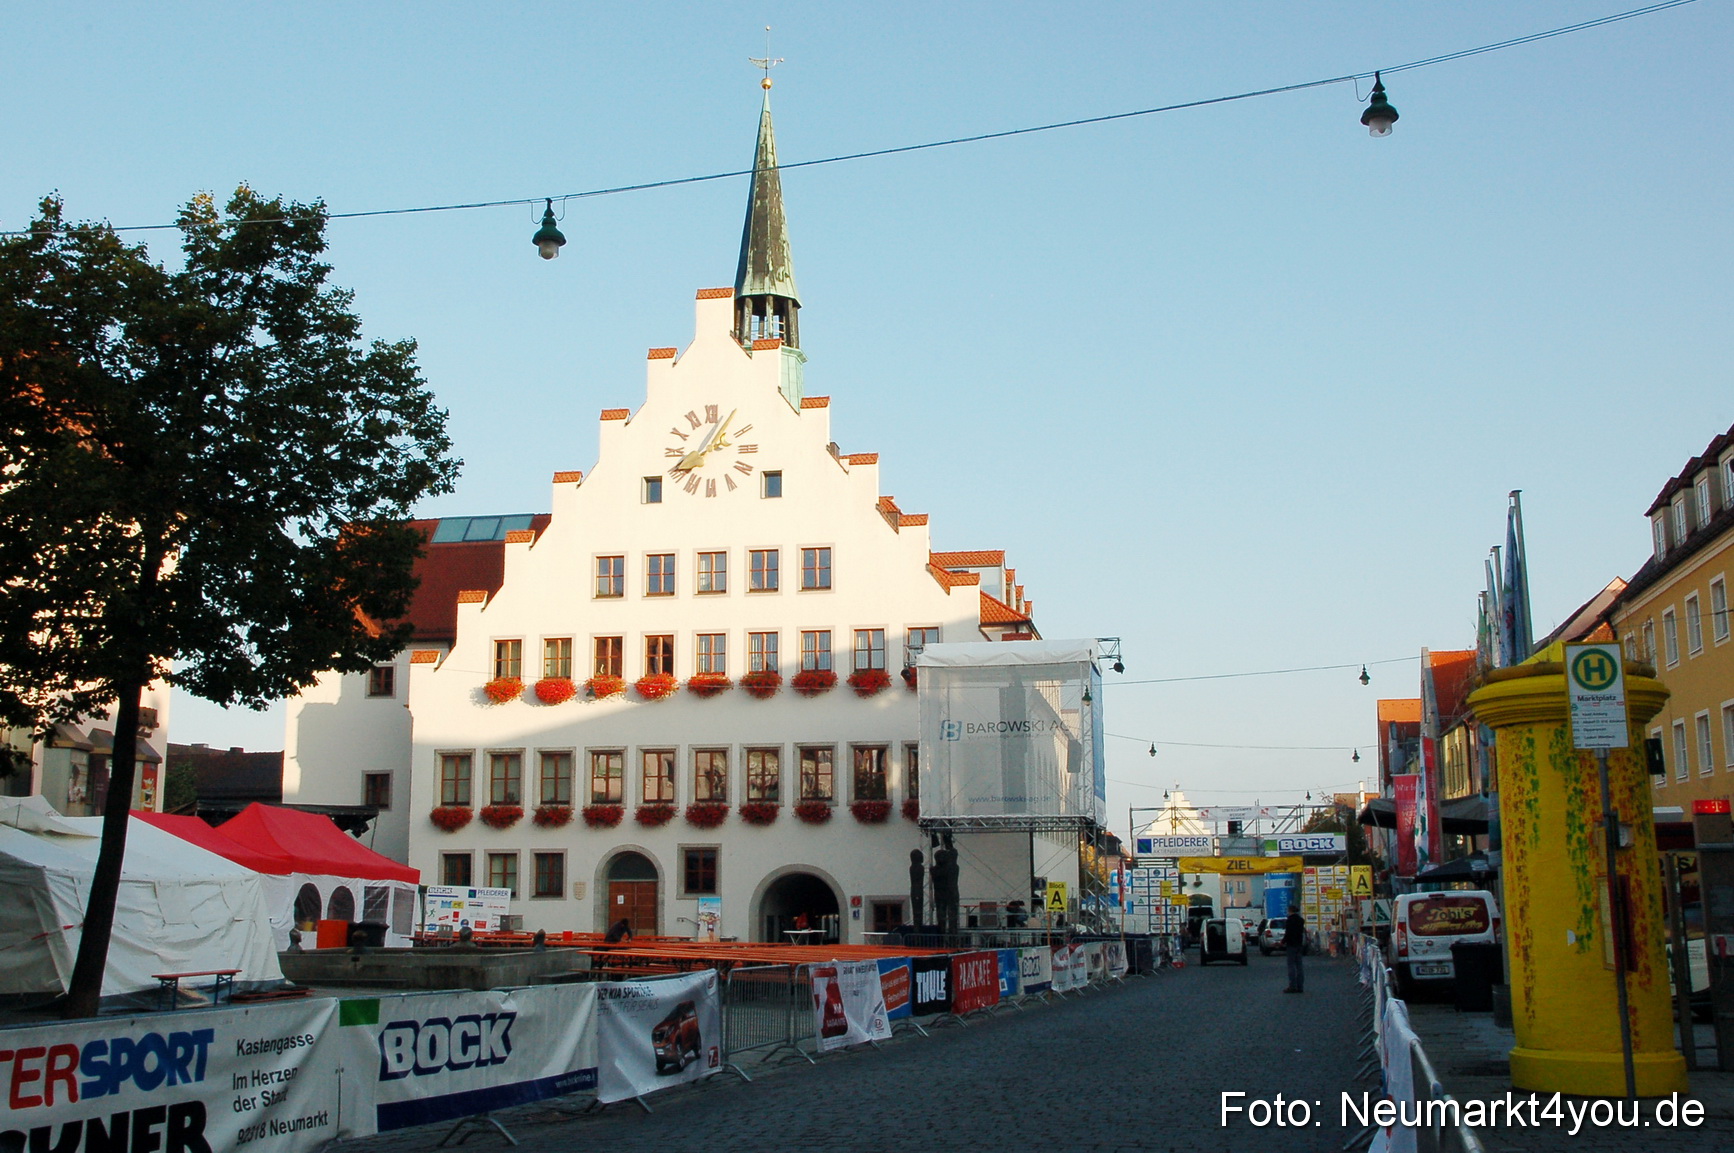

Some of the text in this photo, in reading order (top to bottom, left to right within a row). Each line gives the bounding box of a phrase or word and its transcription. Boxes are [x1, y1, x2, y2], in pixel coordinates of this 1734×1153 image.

[1583, 658, 1606, 681] H
[1577, 694, 1617, 703] Marktplatz
[966, 720, 1045, 734] BAROWSKI
[1153, 837, 1209, 848] PFLEIDERER
[1279, 838, 1335, 850] BOCK
[1227, 860, 1255, 870] ZIEL
[1357, 874, 1369, 890] A
[1051, 890, 1063, 905] A
[916, 969, 946, 1003] THULE
[236, 1033, 314, 1056] Kastengasse
[379, 1012, 517, 1081] BOCK
[233, 1067, 298, 1090] Im Herzen
[233, 1095, 256, 1112] der
[270, 1110, 328, 1136] Neumarkt
